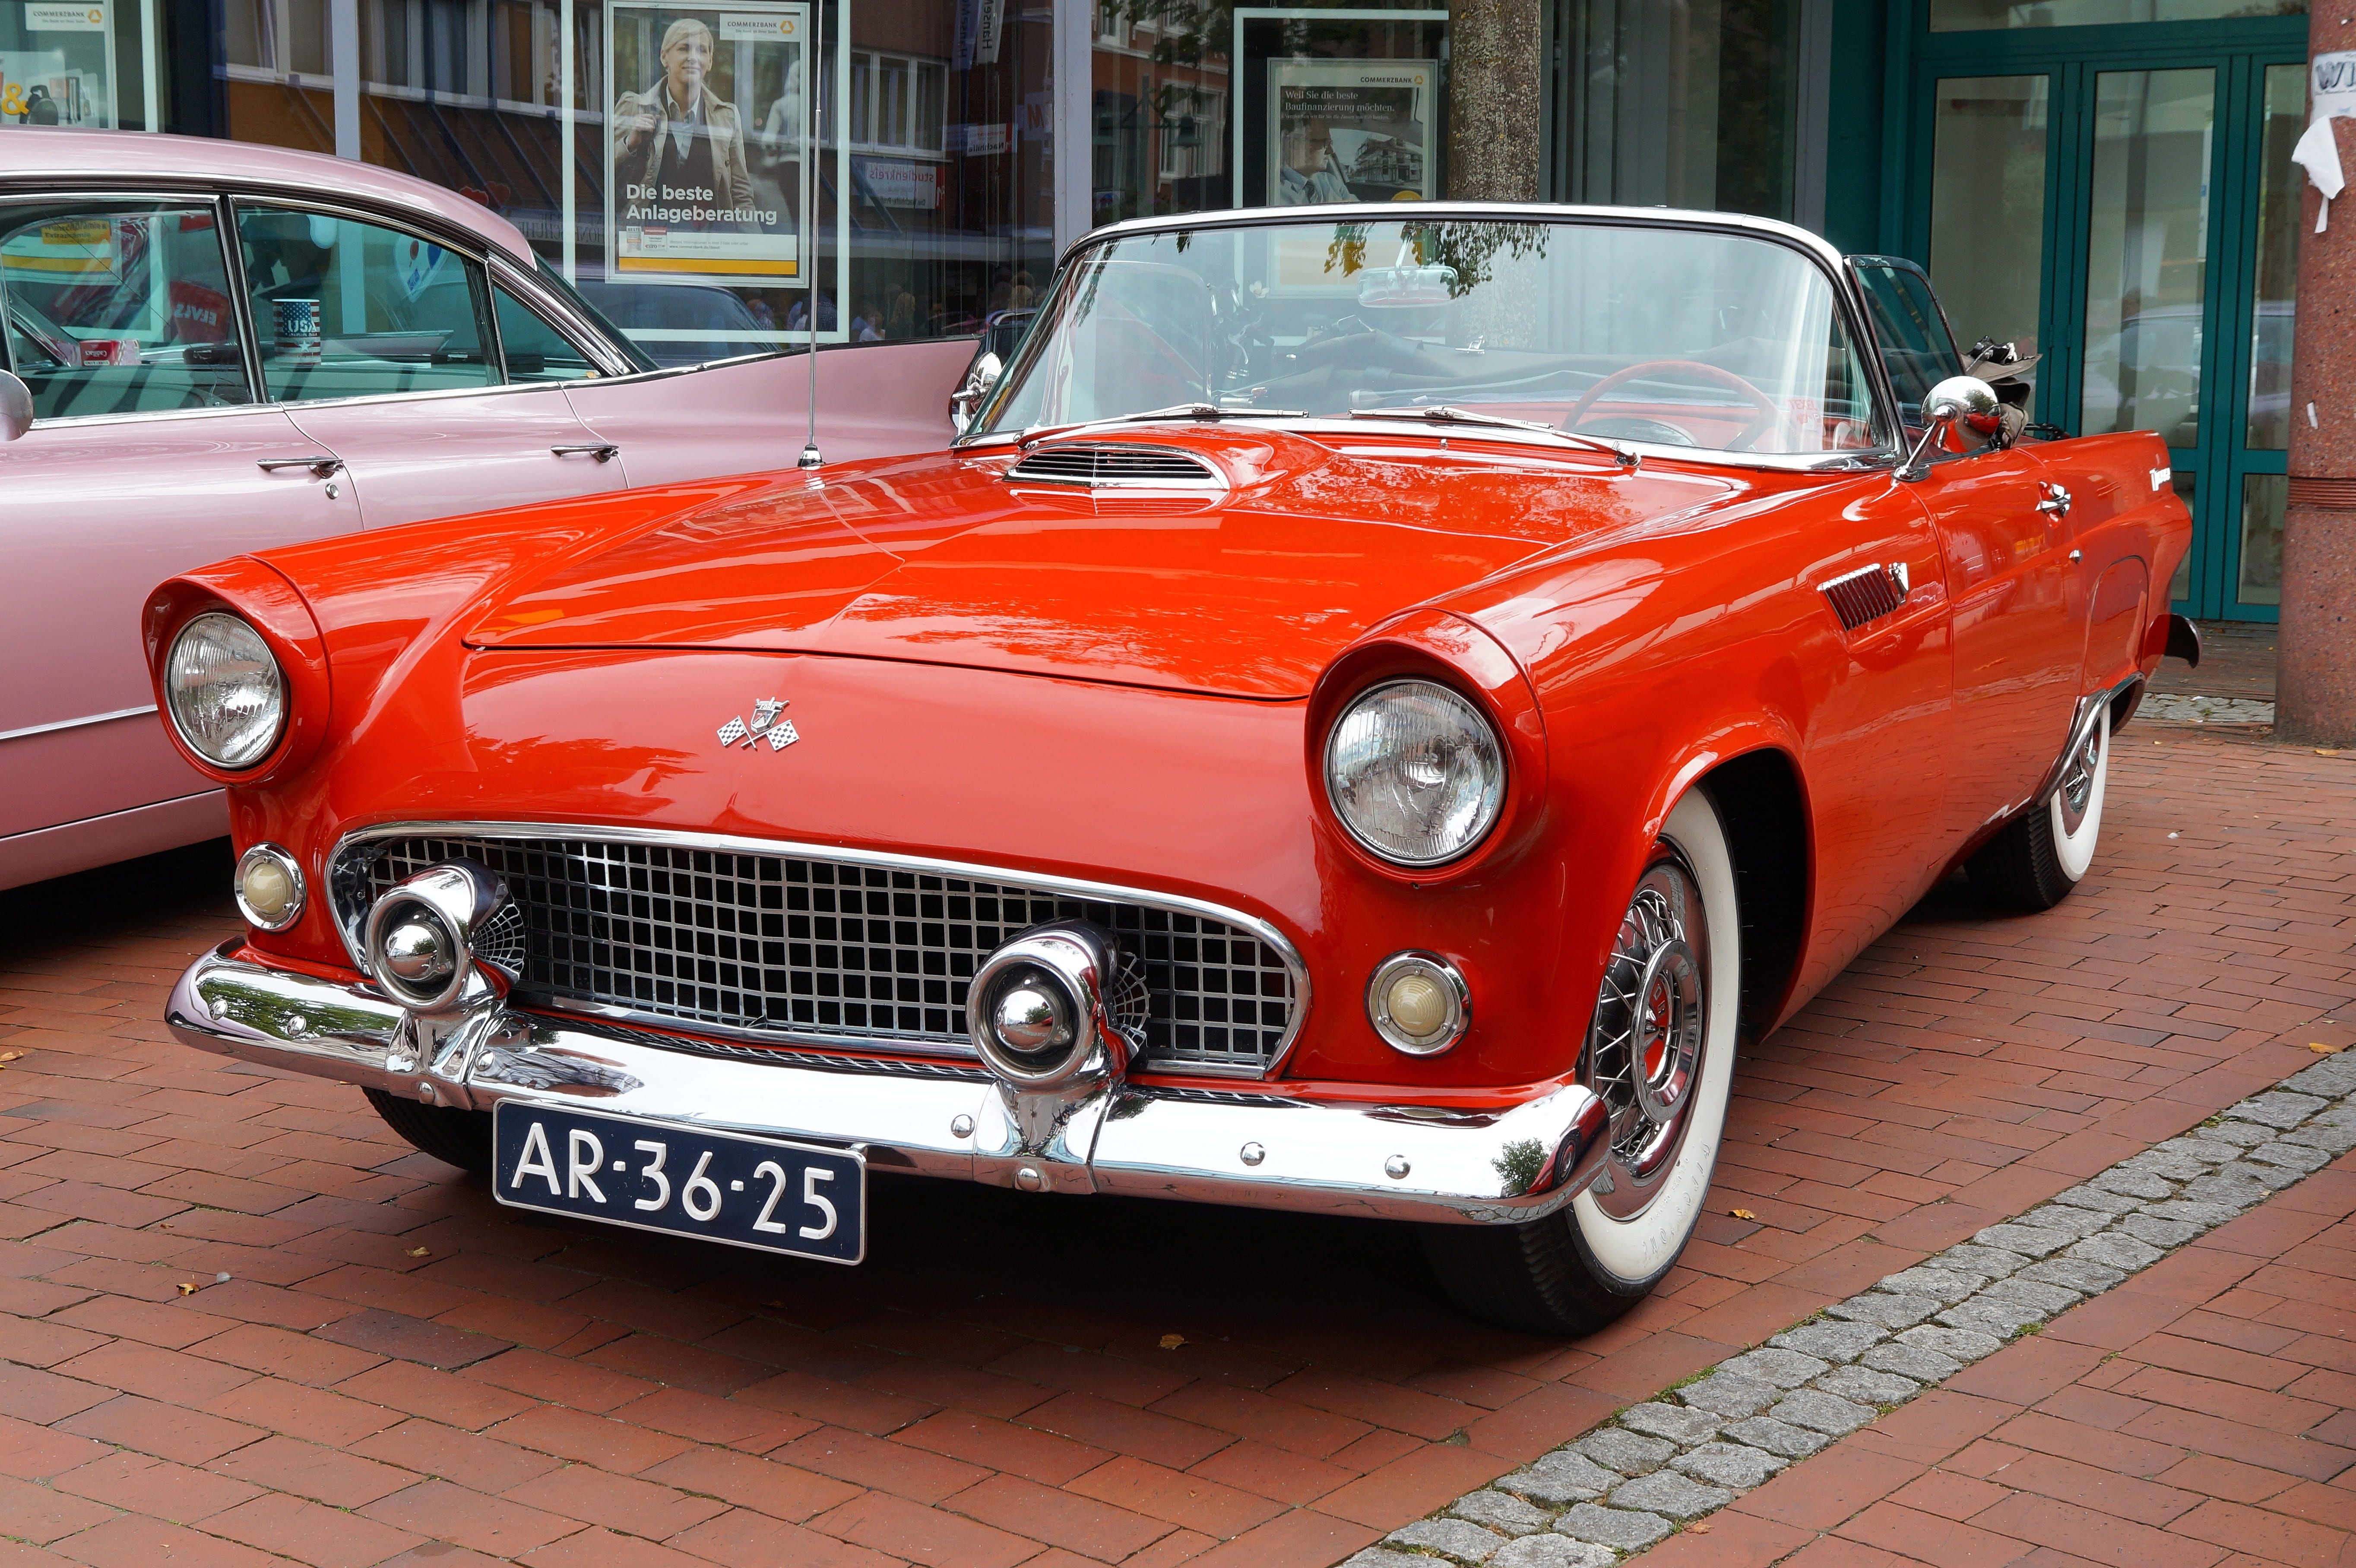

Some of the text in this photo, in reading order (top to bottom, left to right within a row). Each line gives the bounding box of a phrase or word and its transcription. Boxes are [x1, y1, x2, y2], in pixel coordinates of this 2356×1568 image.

[1285, 91, 1358, 100] Weil Sie die beste
[1285, 102, 1395, 113] Baufinanzierung möchten.
[627, 184, 713, 201] Die beste
[626, 204, 777, 225] Anlageberatung
[288, 319, 317, 332] USA
[1787, 399, 1818, 411] TEXEL
[511, 1122, 838, 1240] AR-36-25
